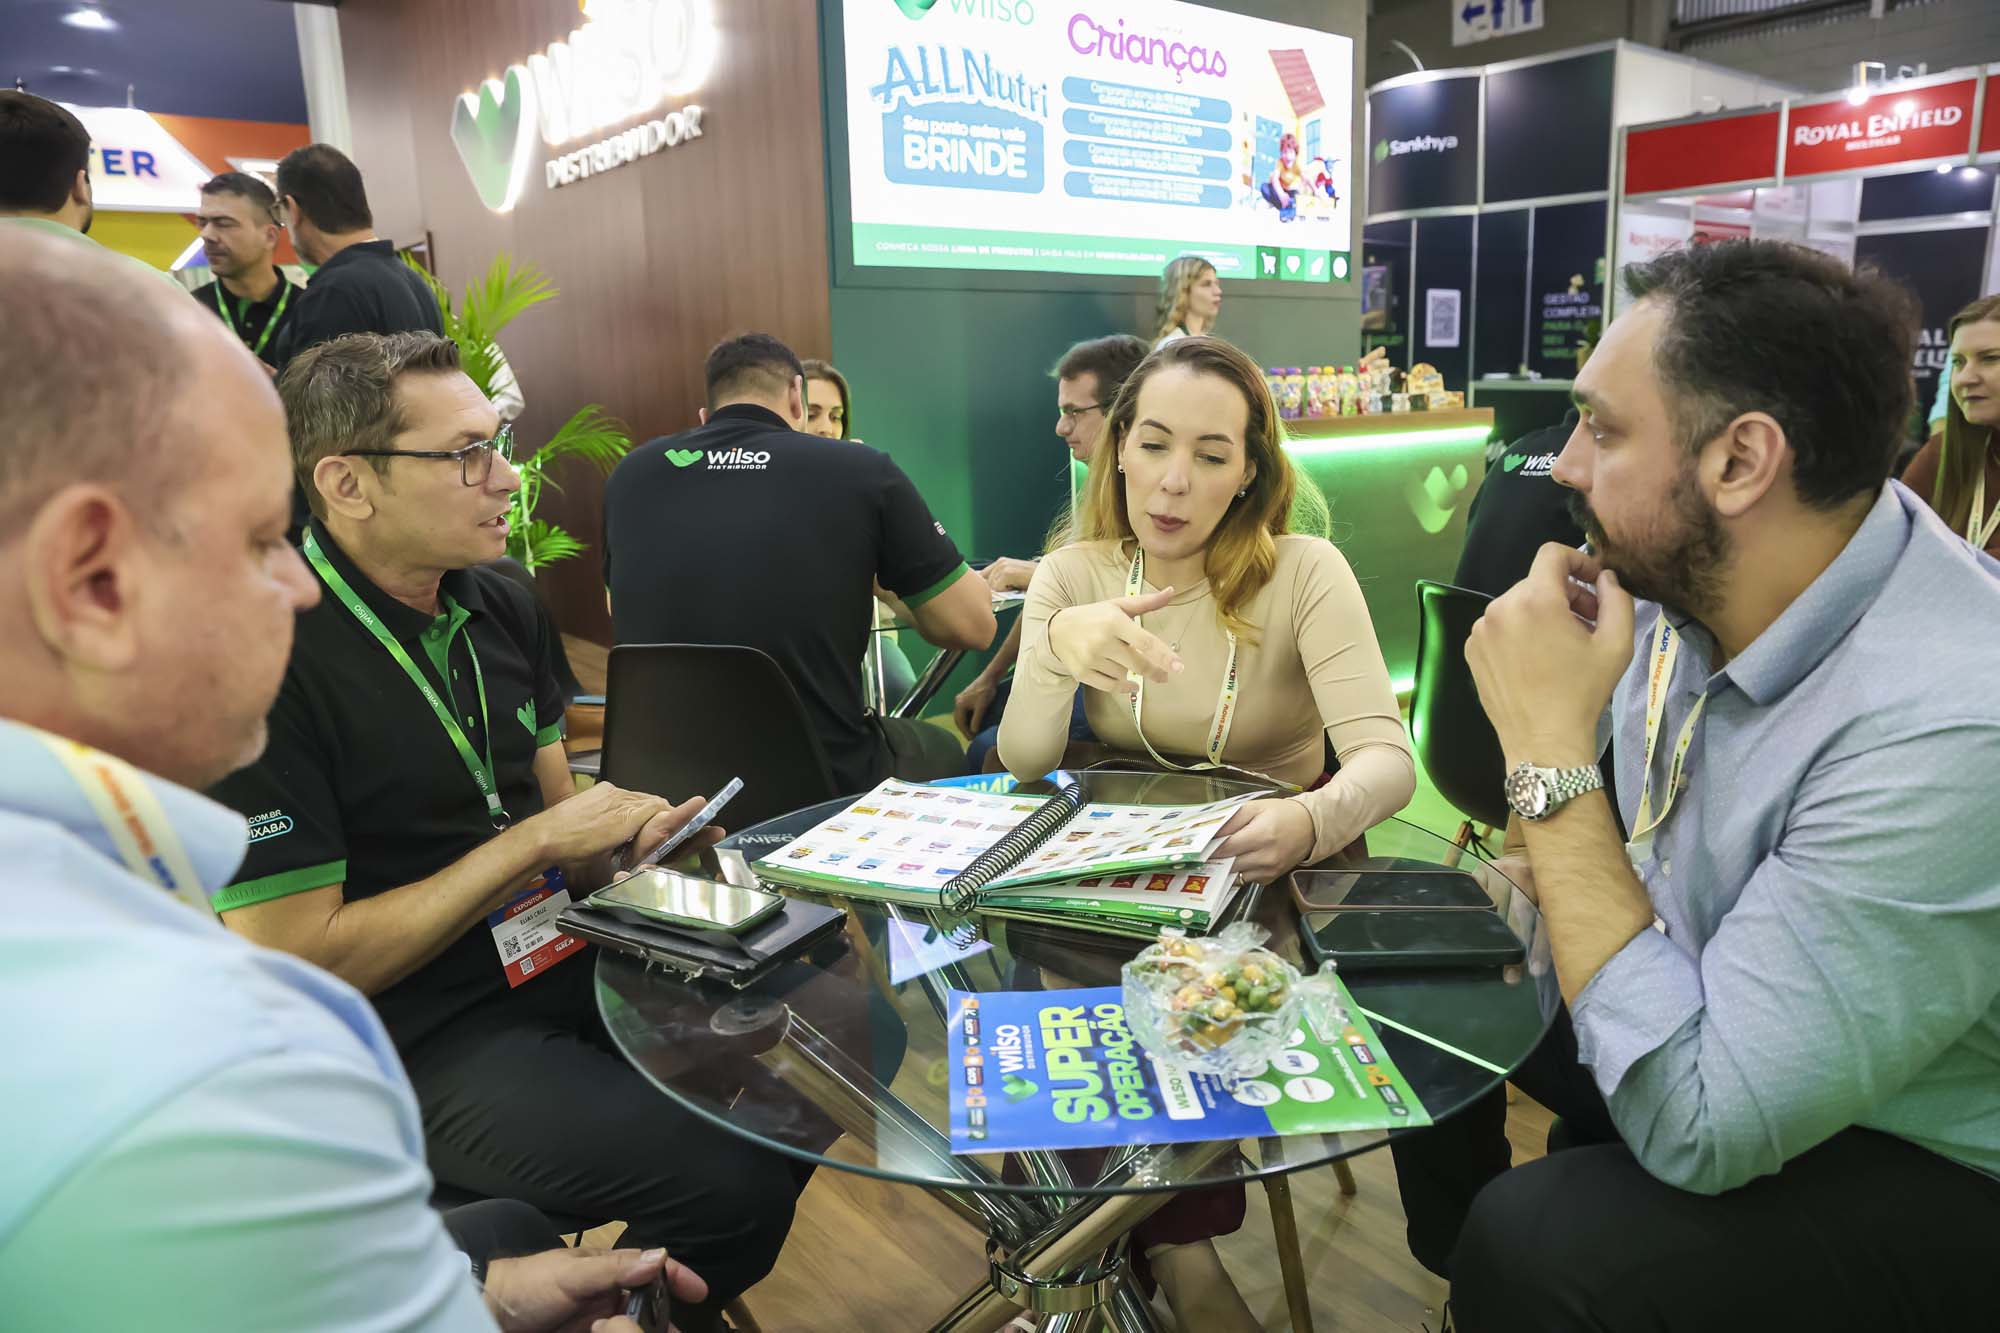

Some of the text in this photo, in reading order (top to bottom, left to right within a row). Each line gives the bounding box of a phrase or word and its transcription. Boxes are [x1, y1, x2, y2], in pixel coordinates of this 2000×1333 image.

[1068, 13, 1227, 84] Crianças
[869, 46, 1048, 118] ALLNutri
[1794, 106, 1962, 146] ROYAL ENFIELD
[545, 105, 703, 188] DISTRIBUIDOR
[903, 134, 1028, 178] BRINDE
[1389, 135, 1458, 156] Sankhya
[706, 448, 771, 465] wilso
[1523, 451, 1557, 471] wils
[354, 604, 374, 626] wilso
[1660, 625, 1672, 653] ACAPS
[1653, 654, 1665, 683] TRADE
[423, 685, 439, 709] wilso
[474, 769, 489, 791] wilso
[512, 893, 544, 914] EXPOSITOR
[989, 1024, 1025, 1074] wilso
[1021, 1024, 1036, 1070] DISTRIBUIDOR
[1088, 1003, 1154, 1121] OPERAÇÃO
[1038, 1005, 1110, 1124] SUPER
[1169, 1078, 1190, 1110] WILSO
